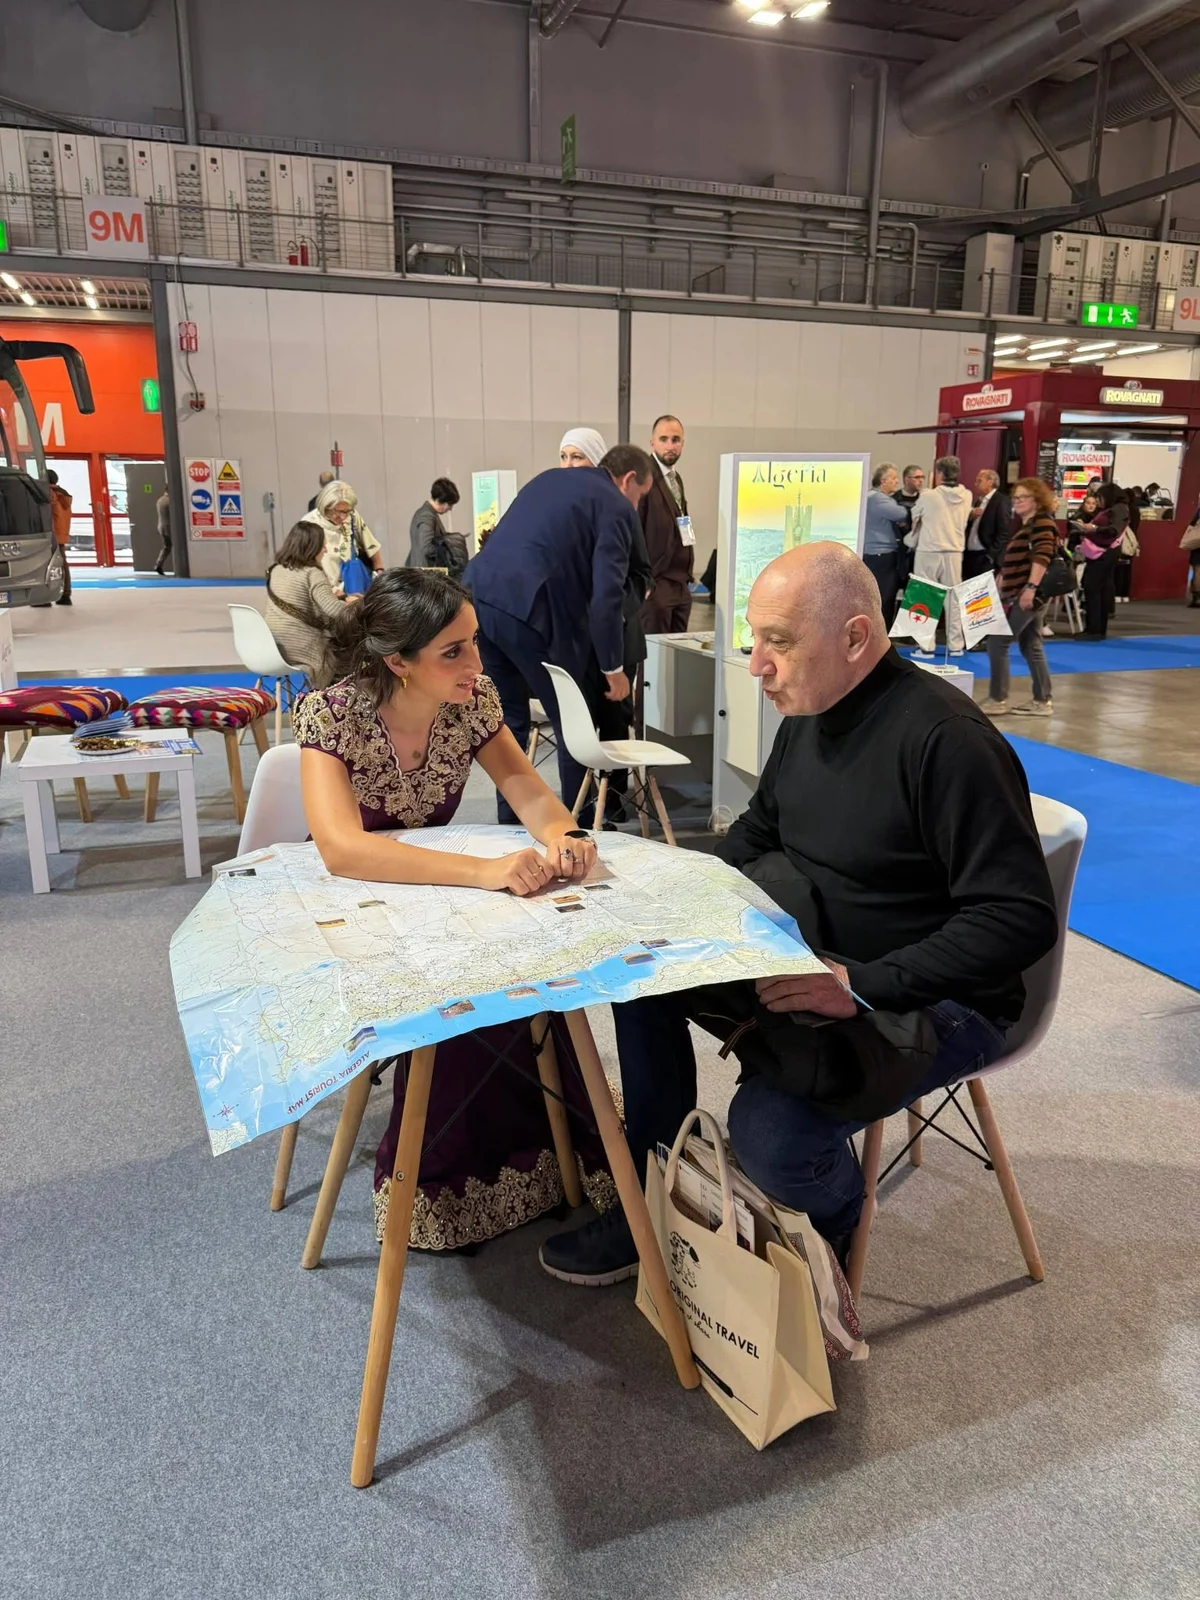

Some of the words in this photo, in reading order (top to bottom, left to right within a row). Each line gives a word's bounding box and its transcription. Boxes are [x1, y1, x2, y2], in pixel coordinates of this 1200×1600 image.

[88, 209, 144, 243] 9M
[965, 393, 1009, 410] ROVAGNATI
[1105, 389, 1162, 404] ROVAGNATI
[1062, 453, 1111, 464] ROVAGNATI
[189, 467, 210, 477] STOP
[752, 461, 826, 489] Algeria
[338, 1050, 370, 1078] ALGERIA
[305, 1075, 339, 1103] TOURIST
[286, 1097, 304, 1115] MAP
[669, 1279, 713, 1330] ORIGINAL
[715, 1321, 760, 1360] TRAVEL
